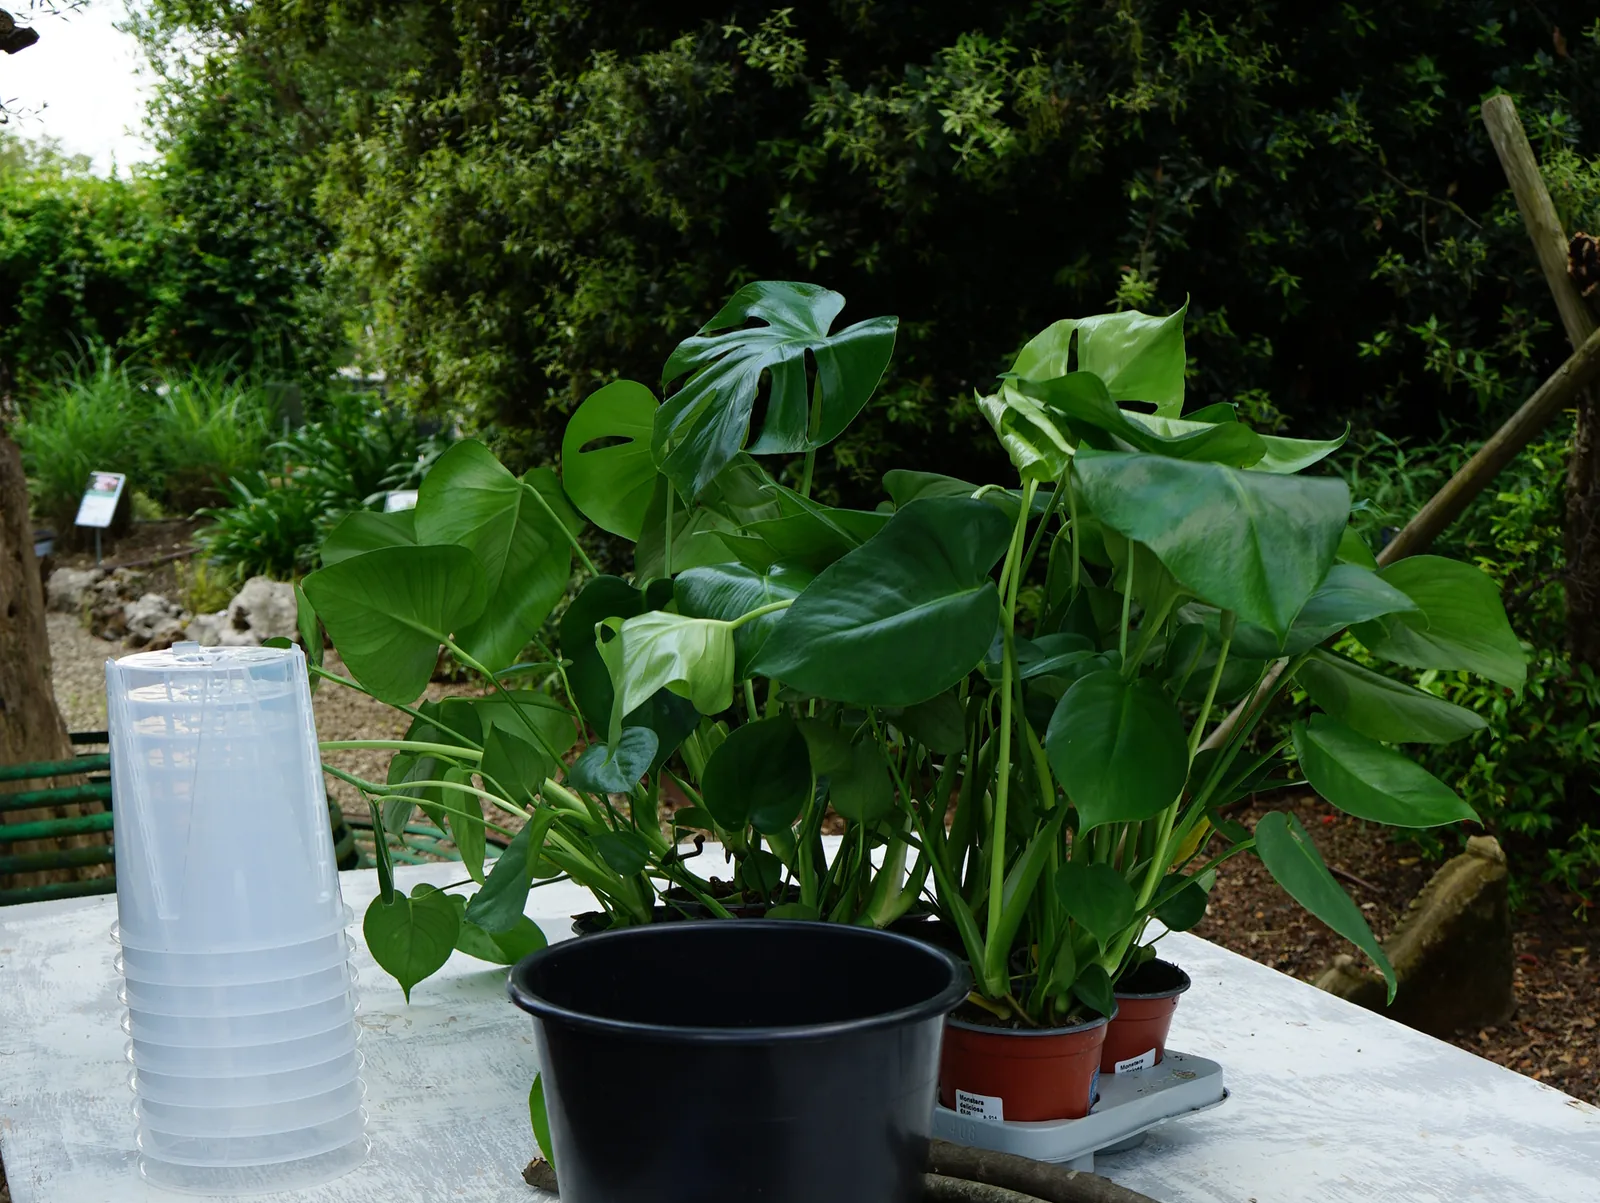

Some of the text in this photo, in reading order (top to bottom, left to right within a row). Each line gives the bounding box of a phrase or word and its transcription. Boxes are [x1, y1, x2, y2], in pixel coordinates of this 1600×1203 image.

[1120, 1059, 1144, 1070] Monstera
[959, 1094, 984, 1106] Monstera
[960, 1102, 984, 1113] deliciosa
